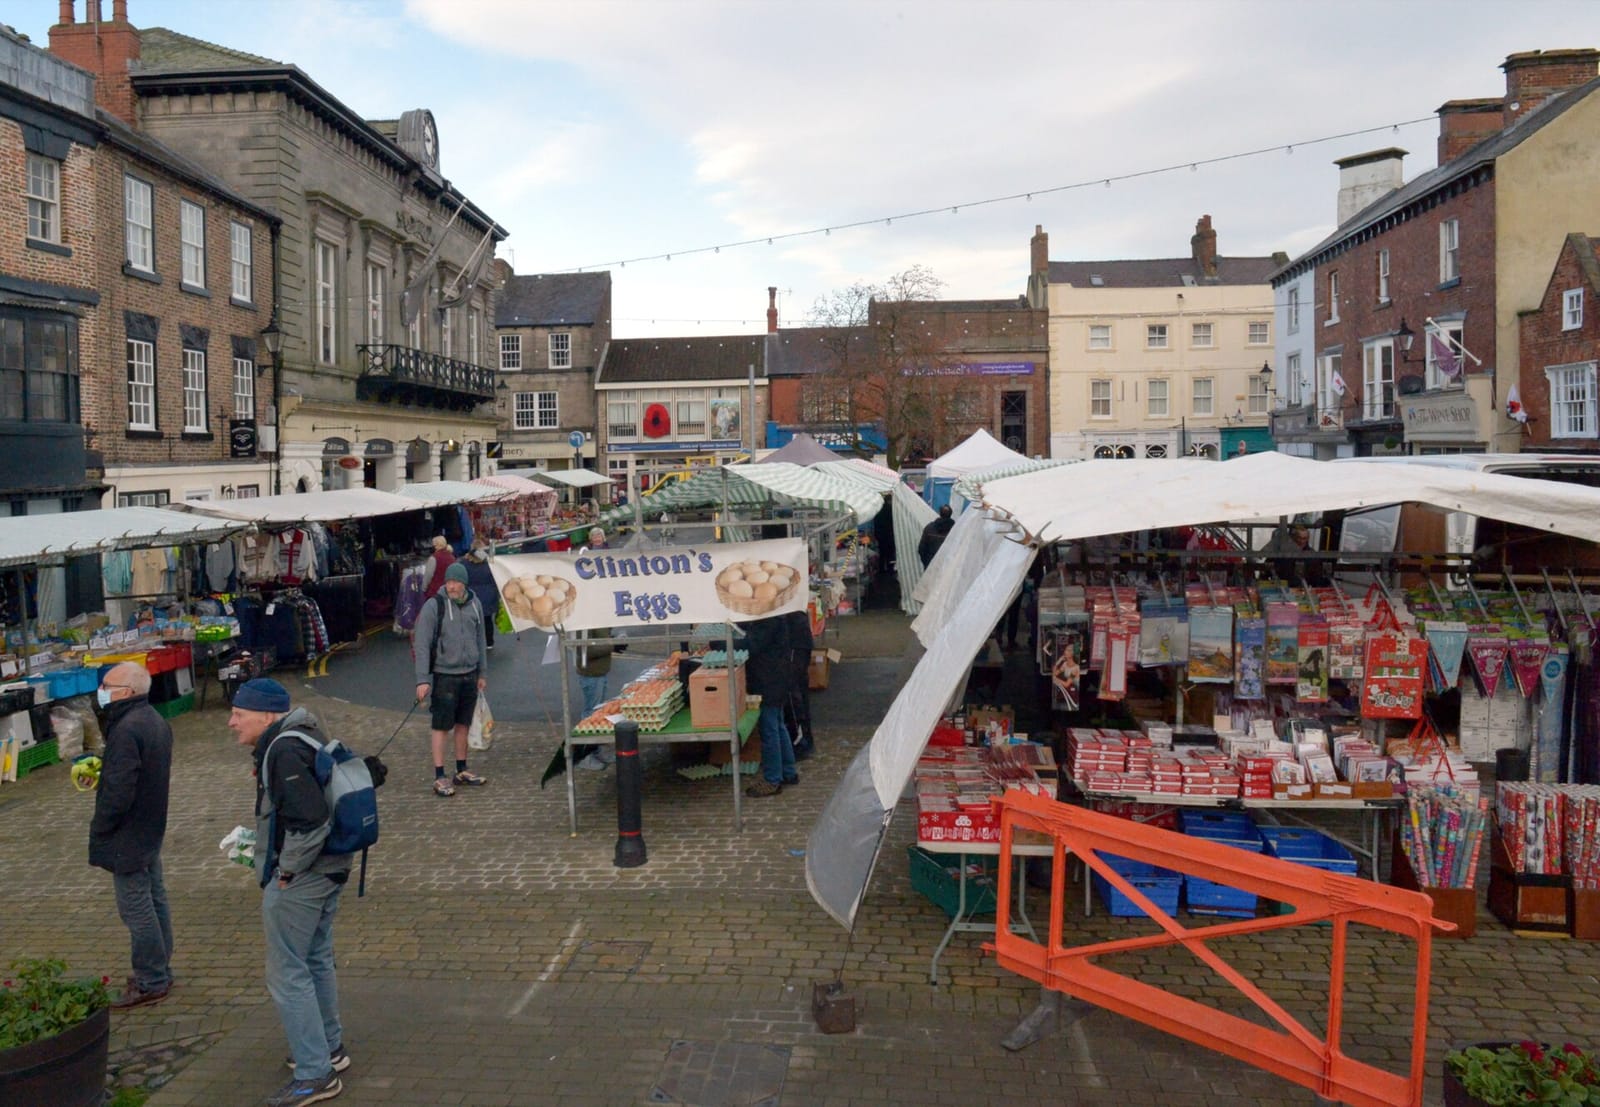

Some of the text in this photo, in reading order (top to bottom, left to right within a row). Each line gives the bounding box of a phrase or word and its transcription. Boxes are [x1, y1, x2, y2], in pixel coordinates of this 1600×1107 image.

[502, 446, 524, 457] mery
[575, 549, 713, 580] Clinton's
[613, 590, 682, 622] Eggs
